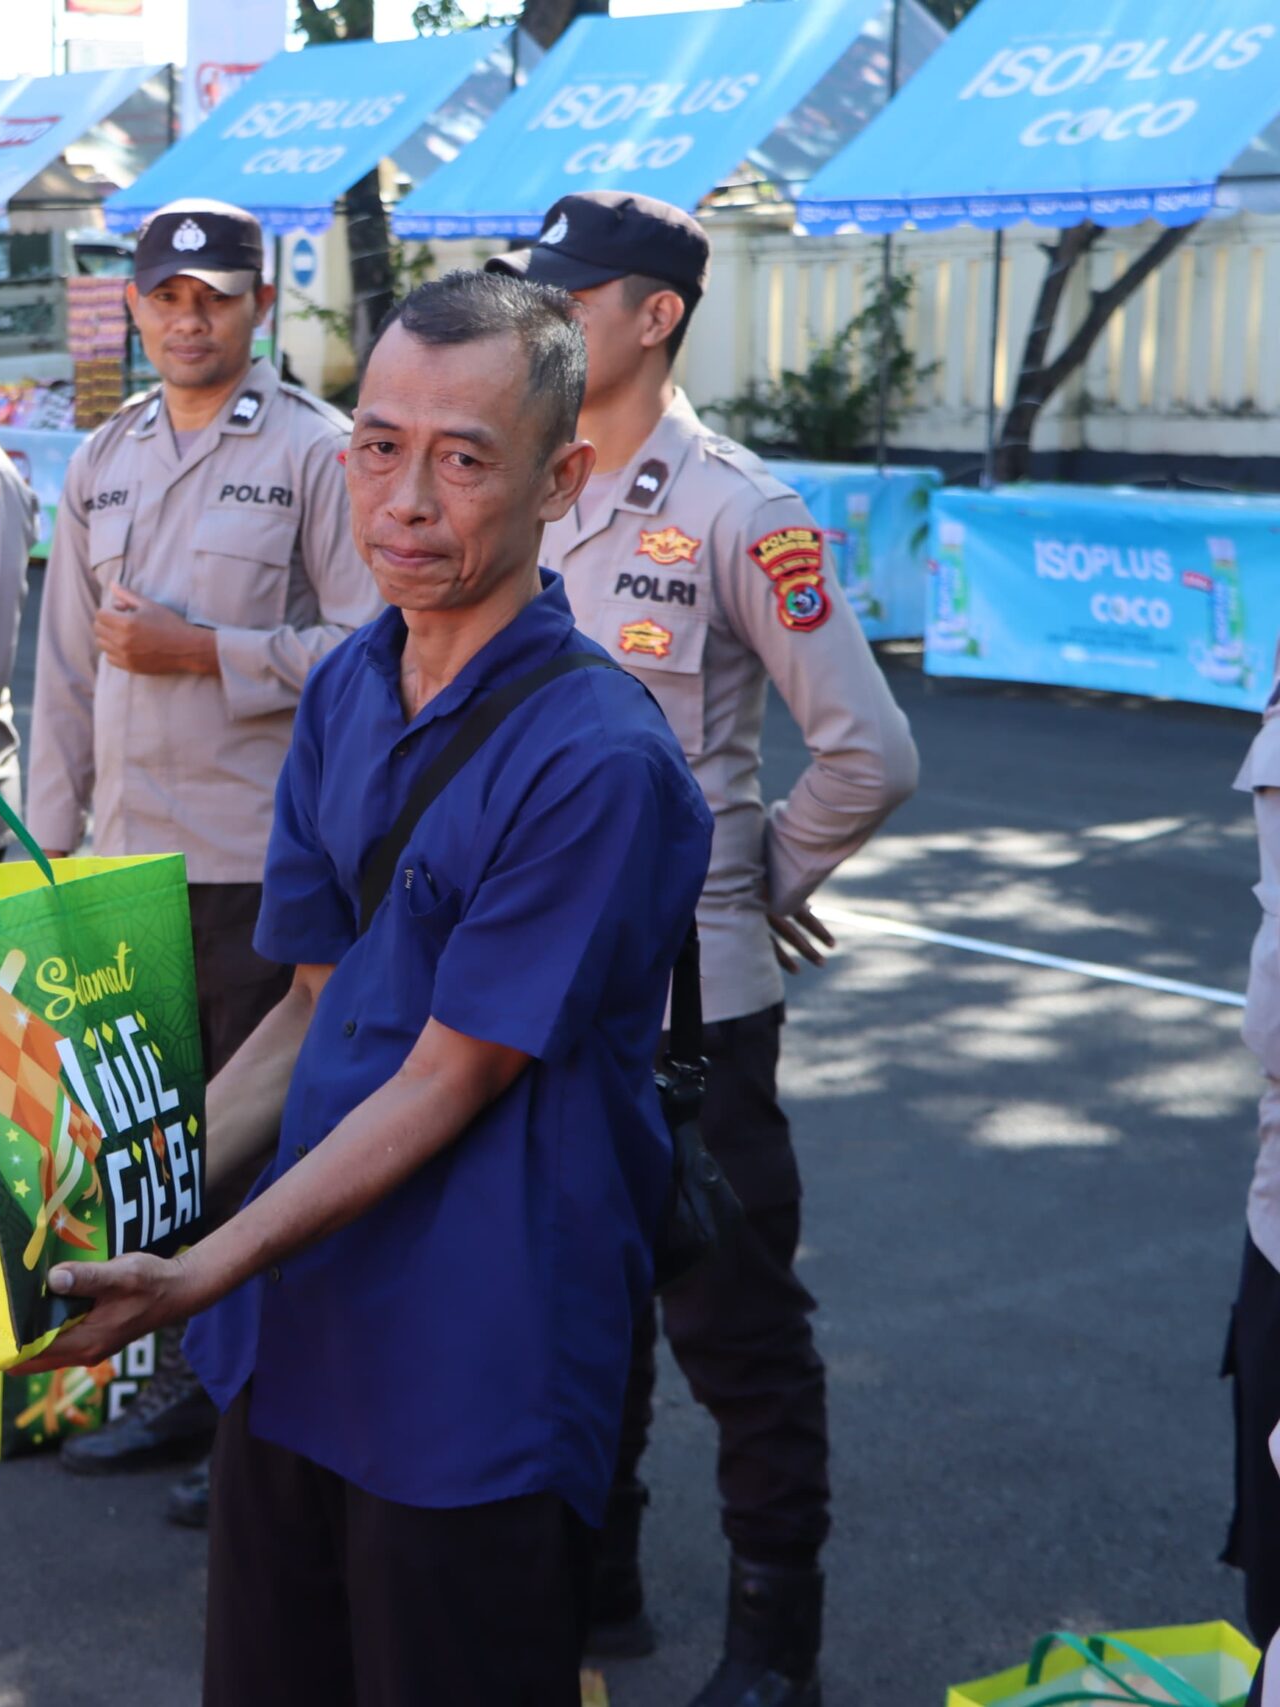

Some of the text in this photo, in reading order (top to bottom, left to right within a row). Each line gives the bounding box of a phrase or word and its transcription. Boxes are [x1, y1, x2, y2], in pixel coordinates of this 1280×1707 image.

[959, 24, 1275, 100] ISOPLUS
[222, 92, 406, 140] ISOPLUS
[527, 71, 760, 132] ISOPLUS
[1019, 99, 1197, 147] COCO
[242, 144, 347, 175] COCO
[563, 134, 694, 175] COCO
[221, 484, 293, 508] POLRI
[1033, 537, 1174, 584] ISOPLUS
[615, 573, 697, 606] POLRI
[1090, 592, 1173, 630] COCO
